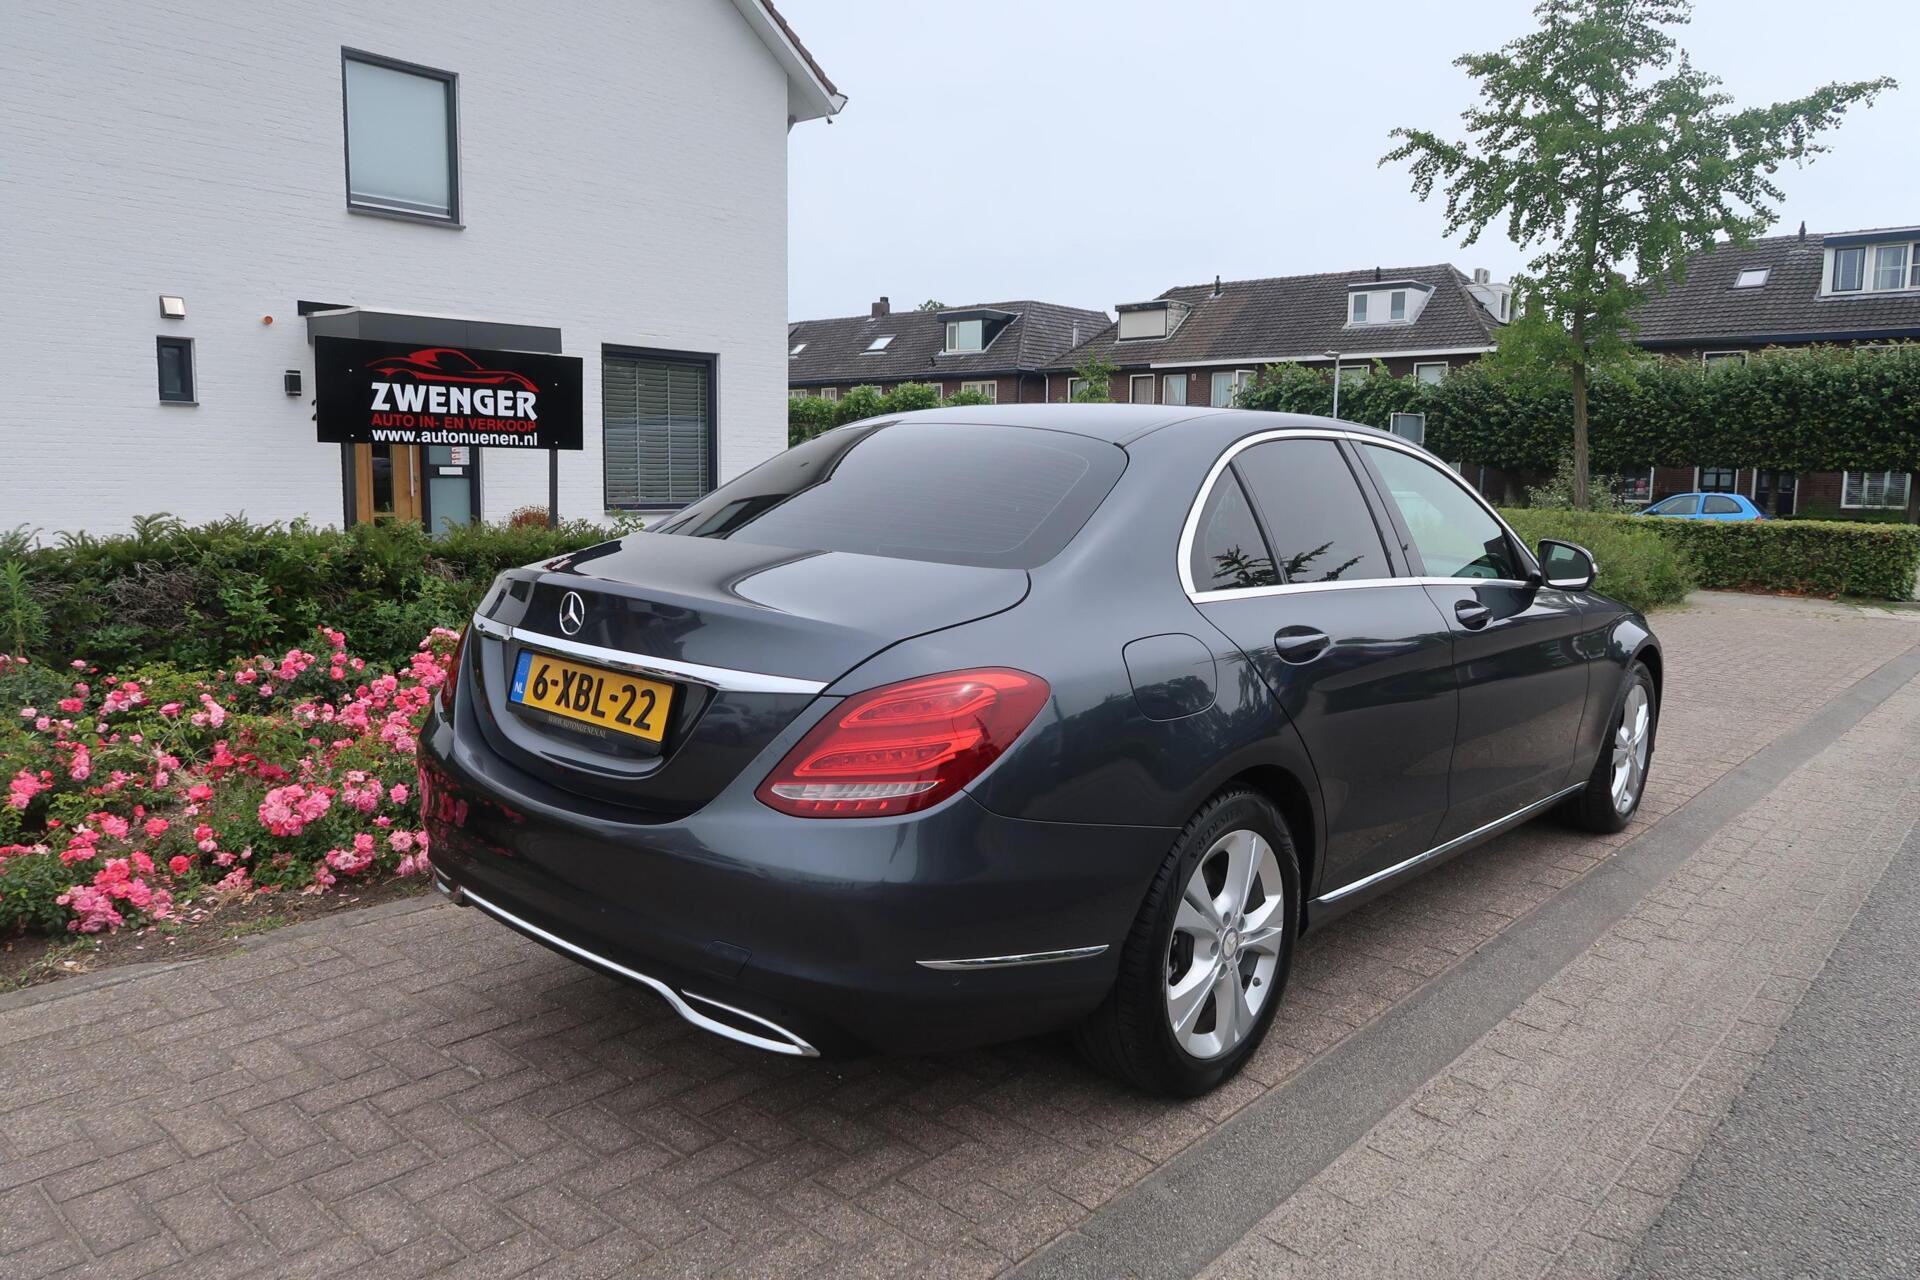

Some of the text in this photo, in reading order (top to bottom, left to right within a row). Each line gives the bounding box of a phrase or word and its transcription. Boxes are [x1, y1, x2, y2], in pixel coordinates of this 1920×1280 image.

[370, 382, 538, 421] ZWENGER
[371, 413, 537, 432] AUTO IN- EN VERKOOP
[371, 429, 538, 446] www.autonuenen.nl
[513, 681, 524, 694] NL
[532, 664, 656, 731] 6-XBL-22
